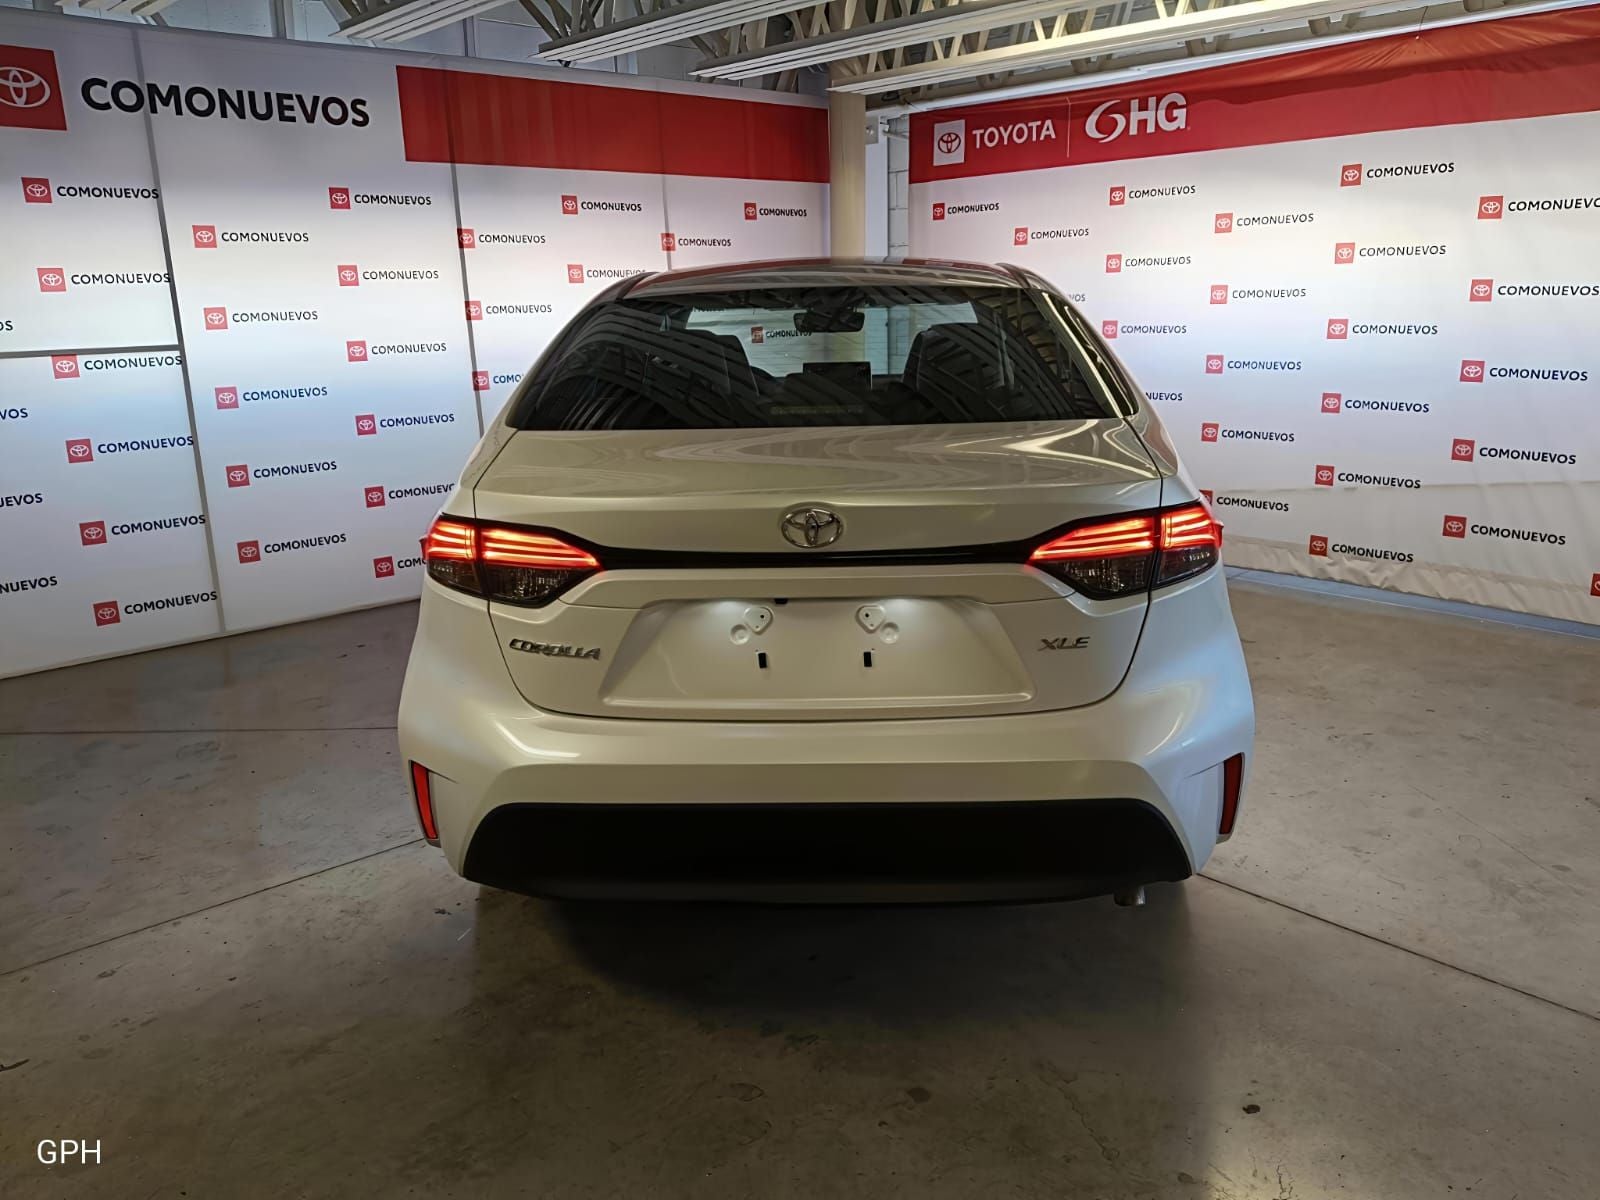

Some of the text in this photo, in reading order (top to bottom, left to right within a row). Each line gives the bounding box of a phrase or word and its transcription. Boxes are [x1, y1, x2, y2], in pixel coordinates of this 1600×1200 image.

[81, 77, 369, 128] COMONUEVOS
[973, 120, 1056, 148] TOYOTA
[1366, 162, 1455, 178] COMONUEVOS
[57, 185, 158, 199] COMONUEVOS
[1129, 185, 1196, 199] COMONUEVOS
[354, 194, 431, 206] COMONUEVOS
[581, 201, 641, 212] COMONUEVOS
[759, 208, 807, 217] COMONUEVOS
[947, 203, 999, 215] COMONUEVOS
[1236, 213, 1314, 227] COMONUEVOS
[221, 231, 309, 243] COMONUEVOS
[478, 233, 546, 245] COMONUEVOS
[1031, 228, 1089, 240] COMONUEVOS
[678, 237, 731, 247] COMONUEVOS
[1359, 245, 1446, 257] COMONUEVOS
[1125, 256, 1191, 267] COMONUEVOS
[71, 272, 171, 285] COMONUEVOS
[362, 270, 439, 281] COMONUEVOS
[1232, 288, 1306, 299] COMONUEVOS
[1497, 285, 1600, 296] COMONUEVOS
[486, 304, 552, 315] COMONUEVOS
[232, 311, 318, 323] COMONUEVOS
[1121, 325, 1187, 336] COMONUEVOS
[1352, 324, 1438, 335] COMONUEVOS
[371, 343, 446, 355] COMONUEVOS
[84, 355, 182, 371] COMONUEVOS
[1227, 360, 1302, 371] COMONUEVOS
[1489, 367, 1588, 381] COMONUEVOS
[242, 387, 327, 402] COMONUEVOS
[1345, 400, 1429, 413] COMONUEVOS
[380, 414, 455, 428] COMONUEVOS
[1221, 429, 1294, 442] COMONUEVOS
[97, 436, 193, 454] COMONUEVOS
[1479, 447, 1577, 465] COMONUEVOS
[253, 461, 337, 479] COMONUEVOS
[1338, 472, 1421, 489] COMONUEVOS
[1216, 496, 1289, 511] COMONUEVOS
[111, 515, 205, 535] COMONUEVOS
[1470, 524, 1566, 546] COMONUEVOS
[264, 534, 346, 554] COMONUEVOS
[1331, 543, 1414, 563] COMONUEVOS
[124, 592, 217, 615] COMONUEVOS
[509, 638, 600, 660] COROLLA
[1037, 636, 1090, 651] XLE
